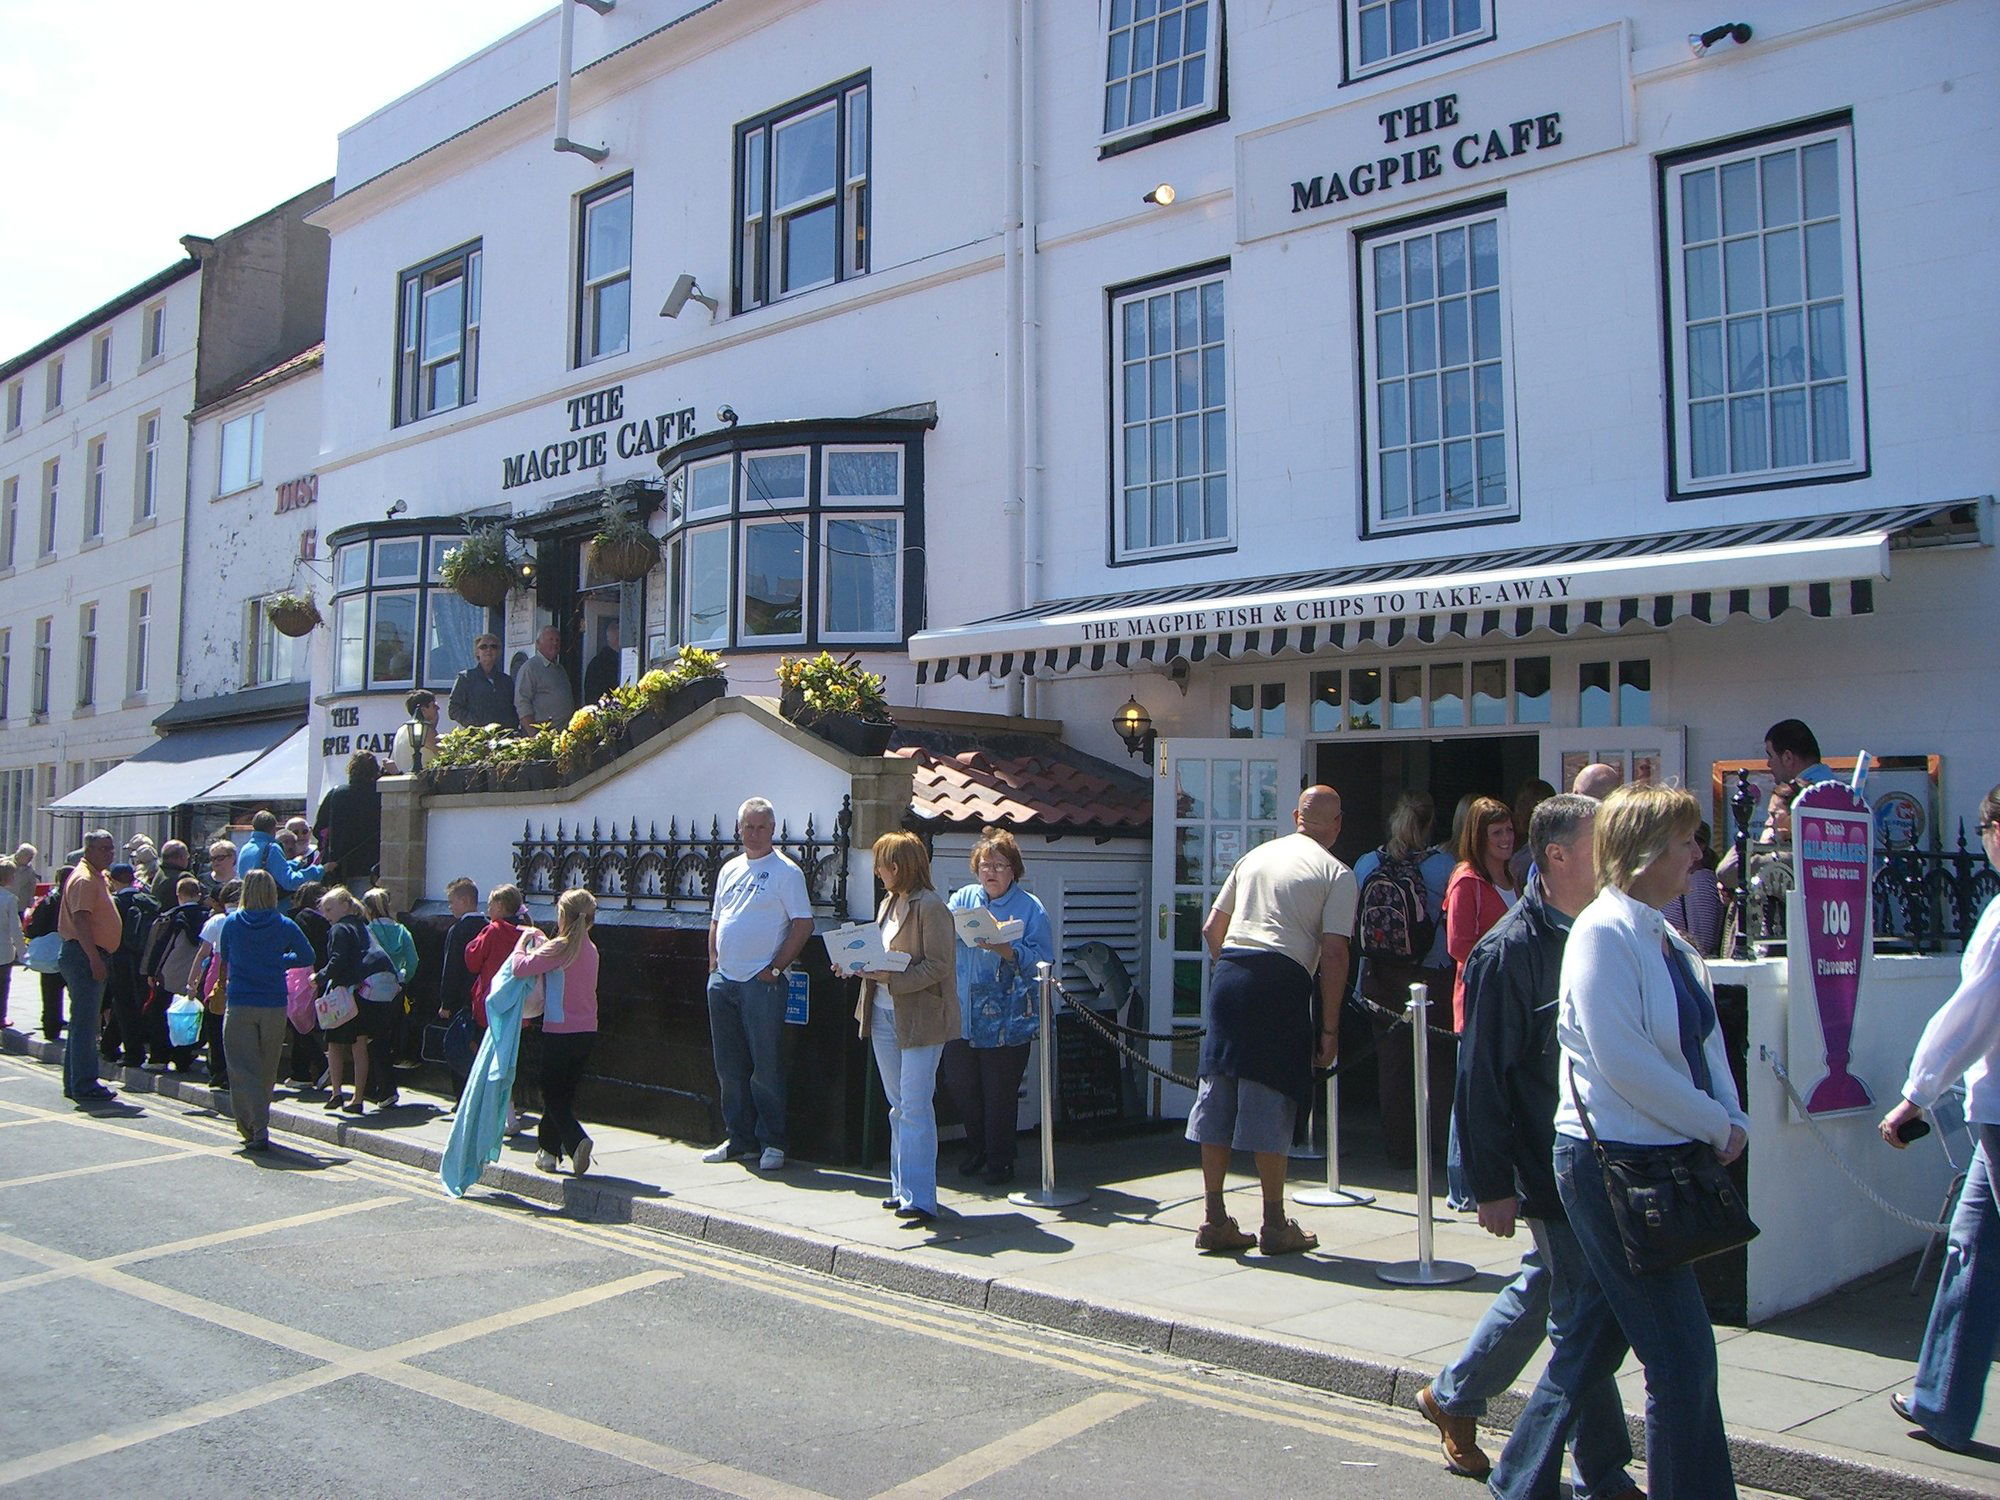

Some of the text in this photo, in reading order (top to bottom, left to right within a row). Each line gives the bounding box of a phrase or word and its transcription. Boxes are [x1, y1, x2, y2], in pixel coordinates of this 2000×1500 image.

[1378, 93, 1460, 144] THE
[1291, 112, 1563, 213] MAGPIE CAFE
[566, 384, 624, 432] THE
[502, 406, 696, 490] MAGPIE CAFE
[1081, 576, 1572, 641] THE MAGPIE FISH & CHIPS TO TAKE-AWAY
[331, 706, 360, 728] THE
[322, 732, 398, 758] PIE CAF
[1825, 820, 1846, 837] Fresh
[1803, 839, 1867, 864] MILKSHAKES
[1811, 864, 1860, 880] with ice cream
[1822, 900, 1851, 935] 100
[1817, 958, 1857, 975] Flavours!
